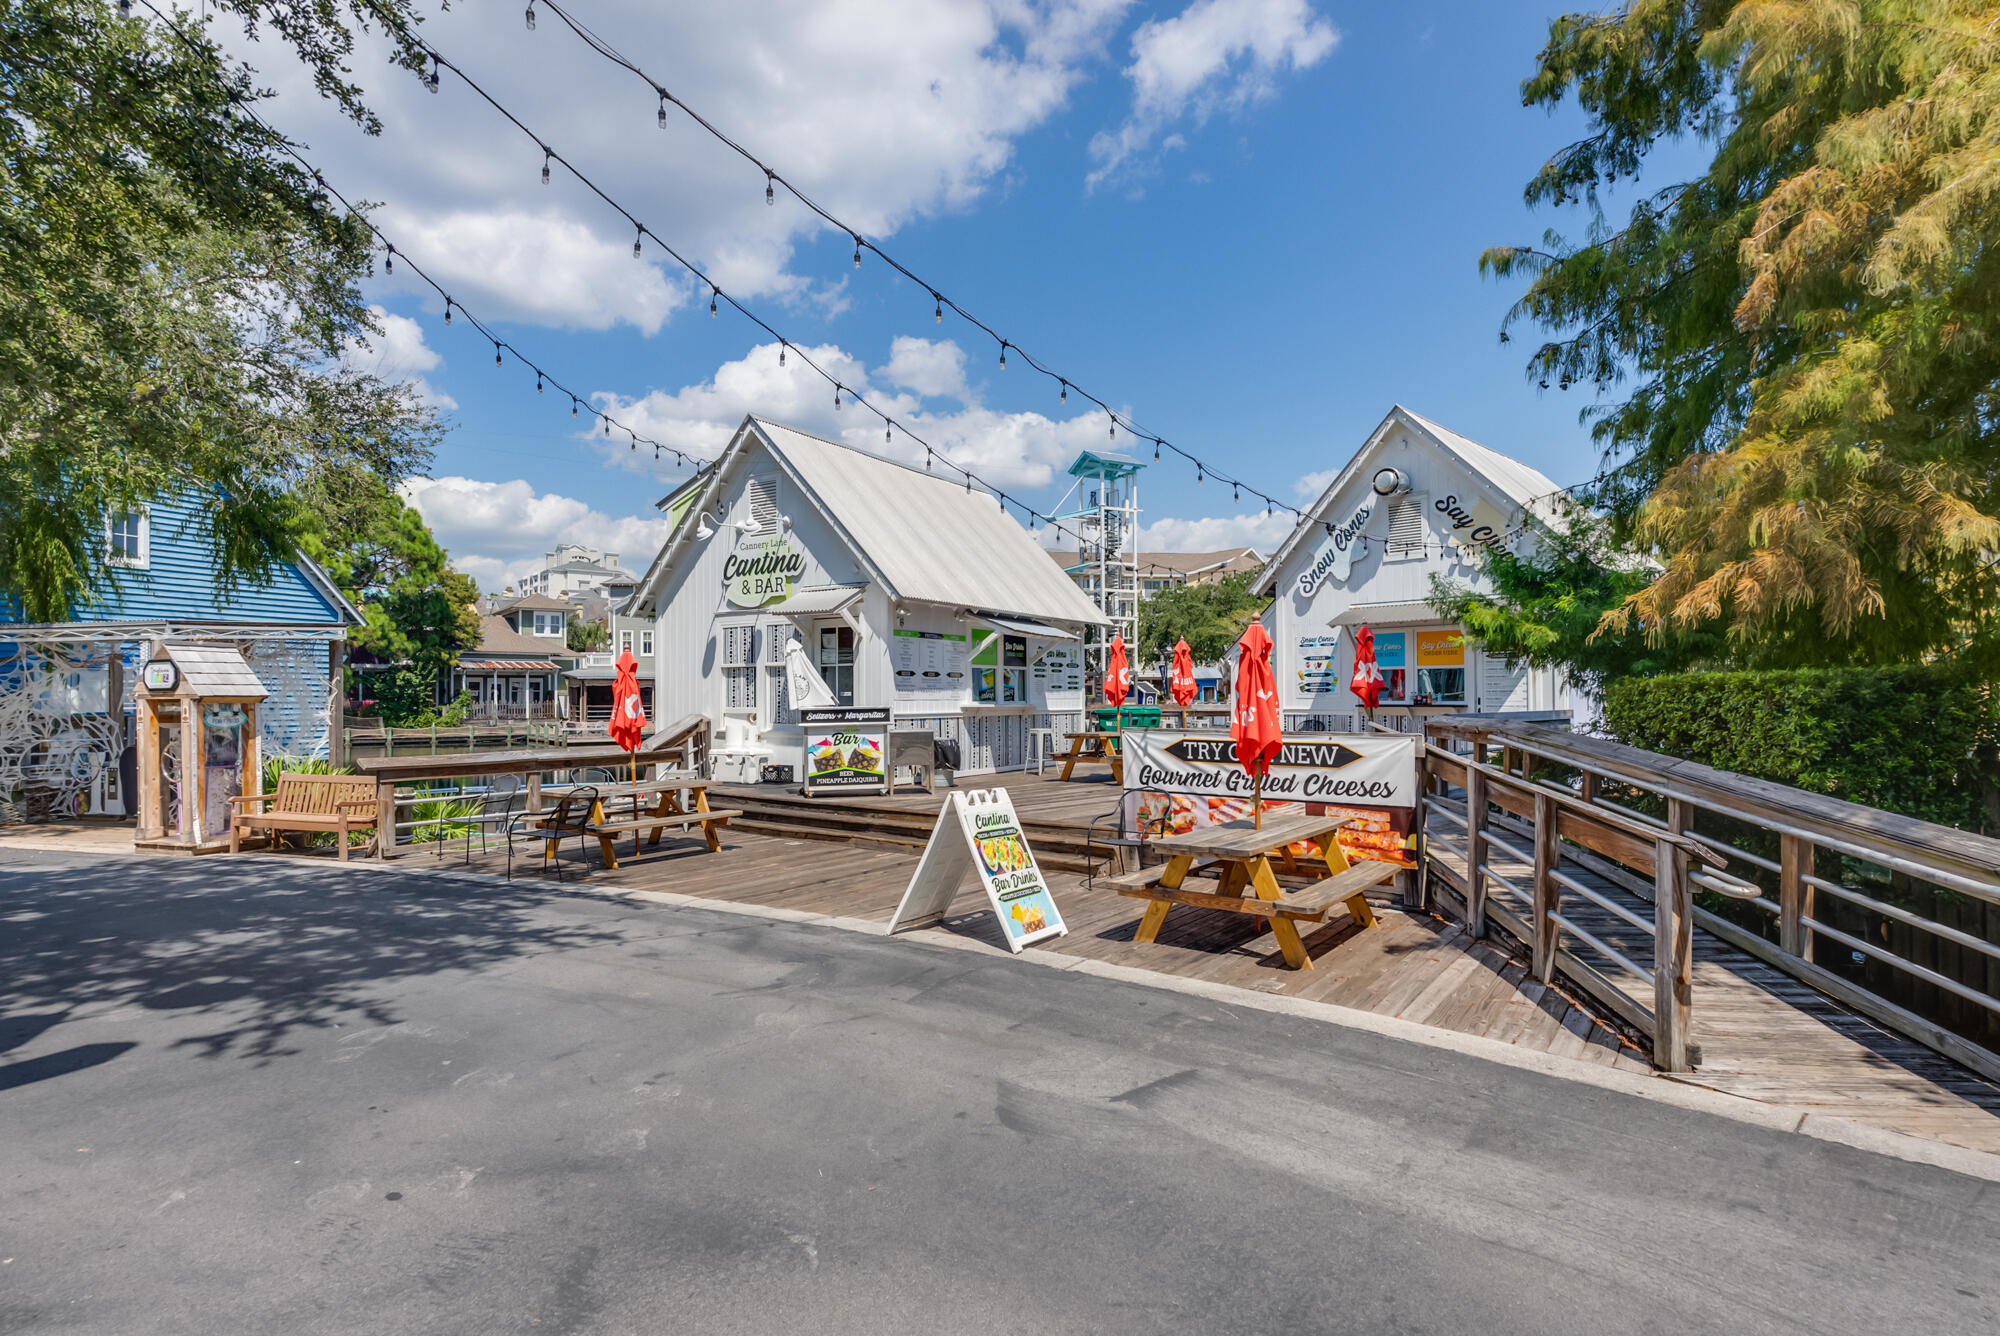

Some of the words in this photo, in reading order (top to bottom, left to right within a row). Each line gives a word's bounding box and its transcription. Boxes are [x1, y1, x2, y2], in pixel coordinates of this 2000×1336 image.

[1435, 495, 1475, 530] Say
[739, 541, 769, 551] Cannery
[770, 539, 788, 547] Lane
[1299, 548, 1336, 594] Snow
[1334, 505, 1371, 552] Cones
[723, 551, 804, 581] Cantina
[741, 580, 751, 595] &
[755, 577, 784, 594] BAR
[1300, 636, 1317, 644] Snow
[1317, 635, 1335, 643] Cones
[806, 712, 836, 720] Seltzers
[844, 711, 886, 720] Margaritas
[831, 732, 861, 746] Bar
[1183, 741, 1224, 760] TRY
[1279, 744, 1339, 766] NEW
[848, 776, 879, 784] DAIQUIRIS
[1139, 764, 1222, 789] Gourmet
[1303, 773, 1397, 798] Cheeses
[975, 812, 1011, 829] Cantina
[991, 877, 1011, 893] Bar
[1010, 870, 1038, 888] Drinks
